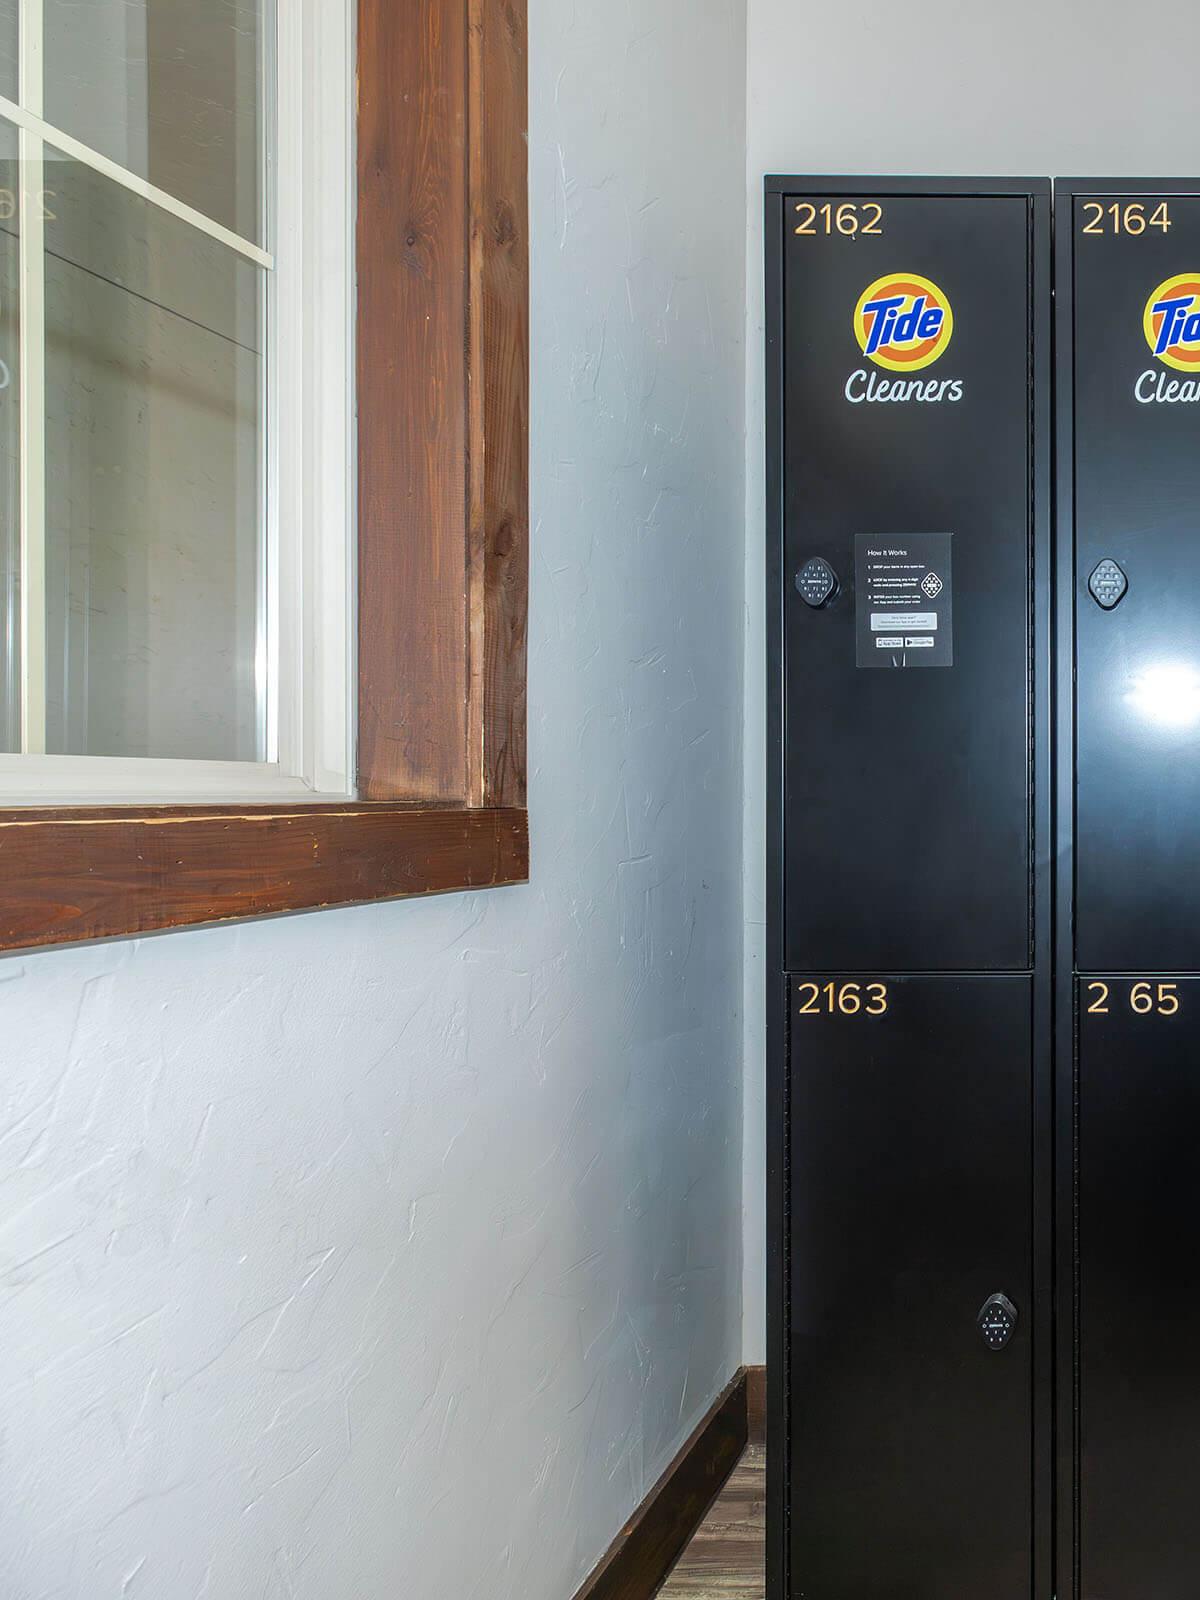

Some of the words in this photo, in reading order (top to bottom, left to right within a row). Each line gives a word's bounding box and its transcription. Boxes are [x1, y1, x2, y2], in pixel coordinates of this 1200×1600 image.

[794, 202, 882, 235] 2162
[1084, 202, 1170, 235] 2164
[861, 295, 945, 356] Tide
[844, 369, 963, 404] Cleaners
[799, 982, 888, 1014] 2163
